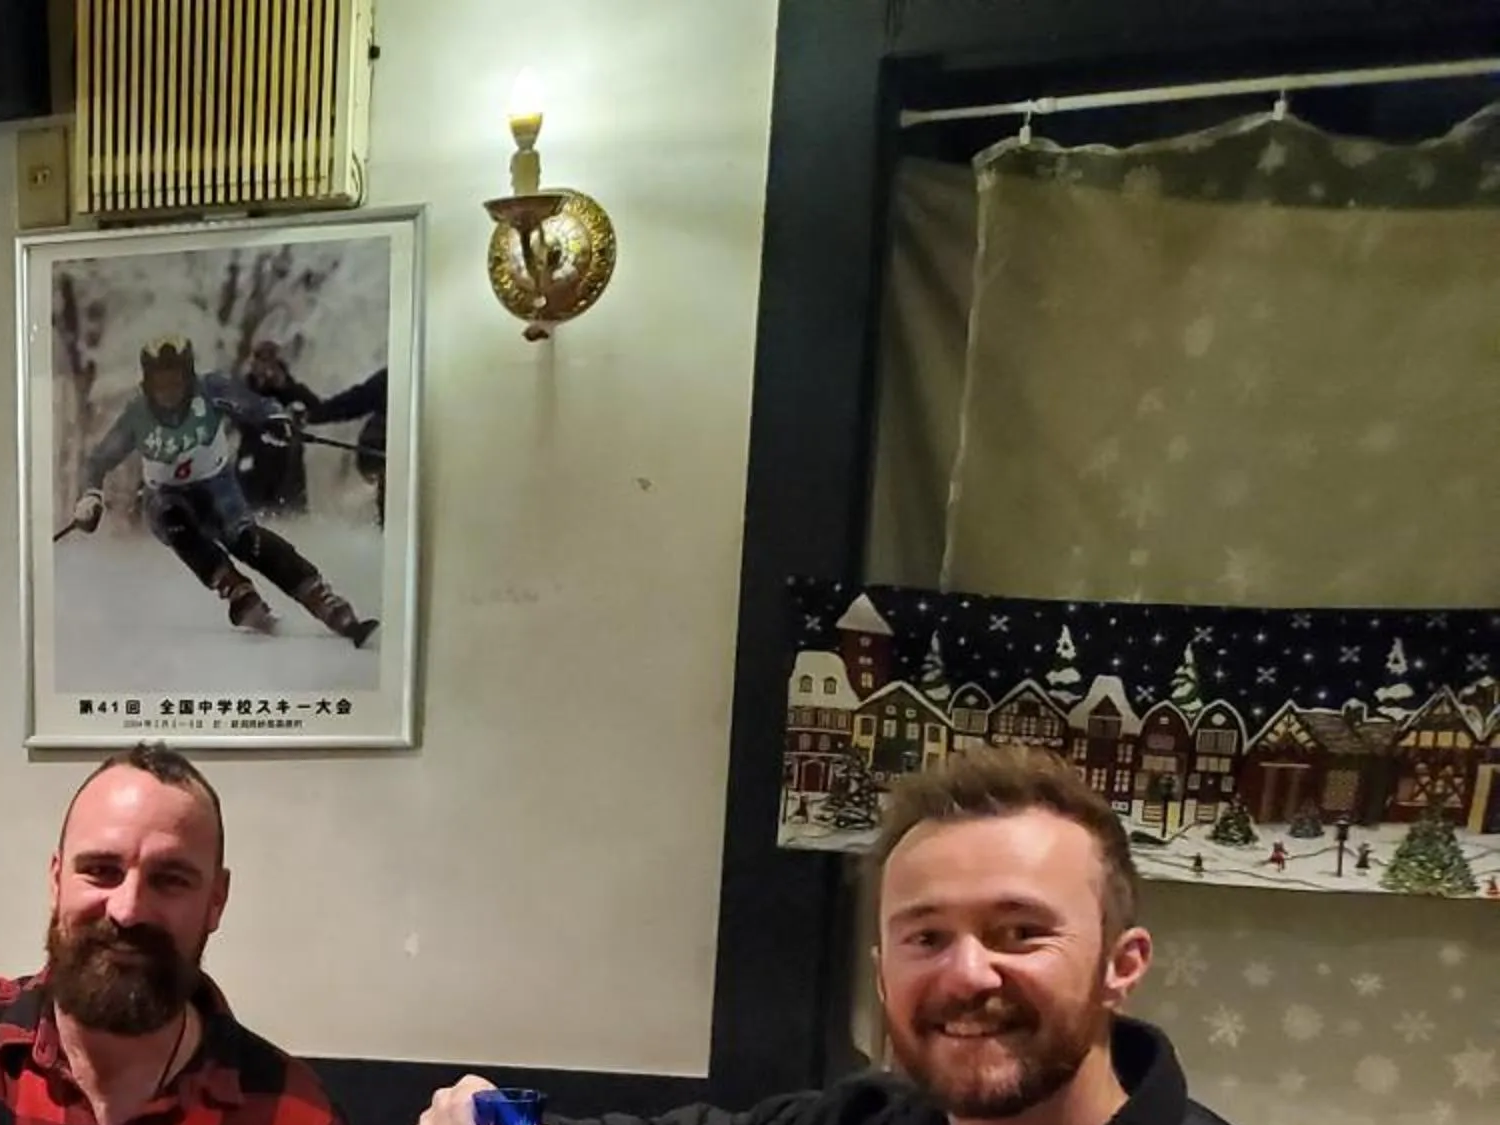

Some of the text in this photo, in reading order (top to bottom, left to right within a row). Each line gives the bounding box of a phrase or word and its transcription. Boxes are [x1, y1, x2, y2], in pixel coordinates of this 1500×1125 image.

[79, 698, 353, 715] 第41回 全国中学校スキー大会
